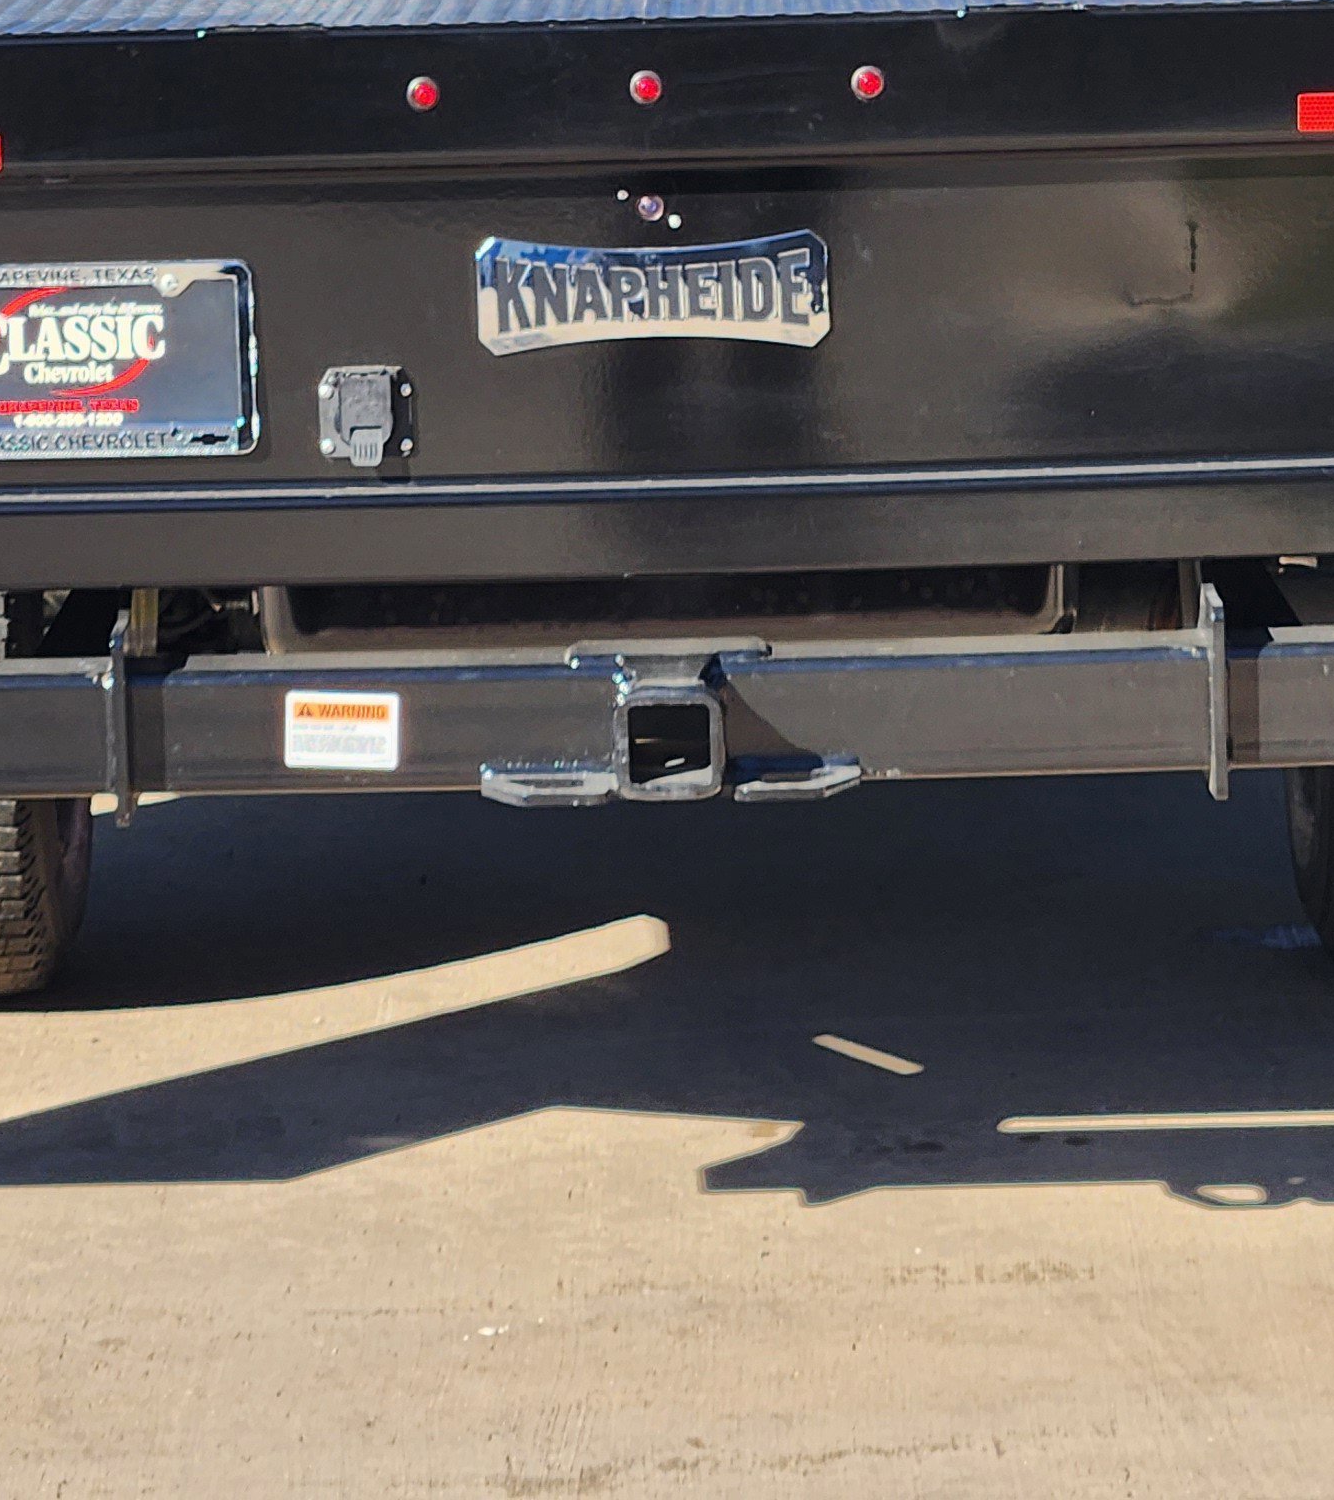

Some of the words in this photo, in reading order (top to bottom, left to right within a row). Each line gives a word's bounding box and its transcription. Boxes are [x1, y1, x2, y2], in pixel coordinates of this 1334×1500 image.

[91, 267, 156, 281] TEXAS
[495, 246, 811, 334] KNAPHEIDE
[23, 361, 115, 384] Chevrolet
[54, 431, 168, 450] CHEVROLET
[318, 704, 386, 719] WARNING
